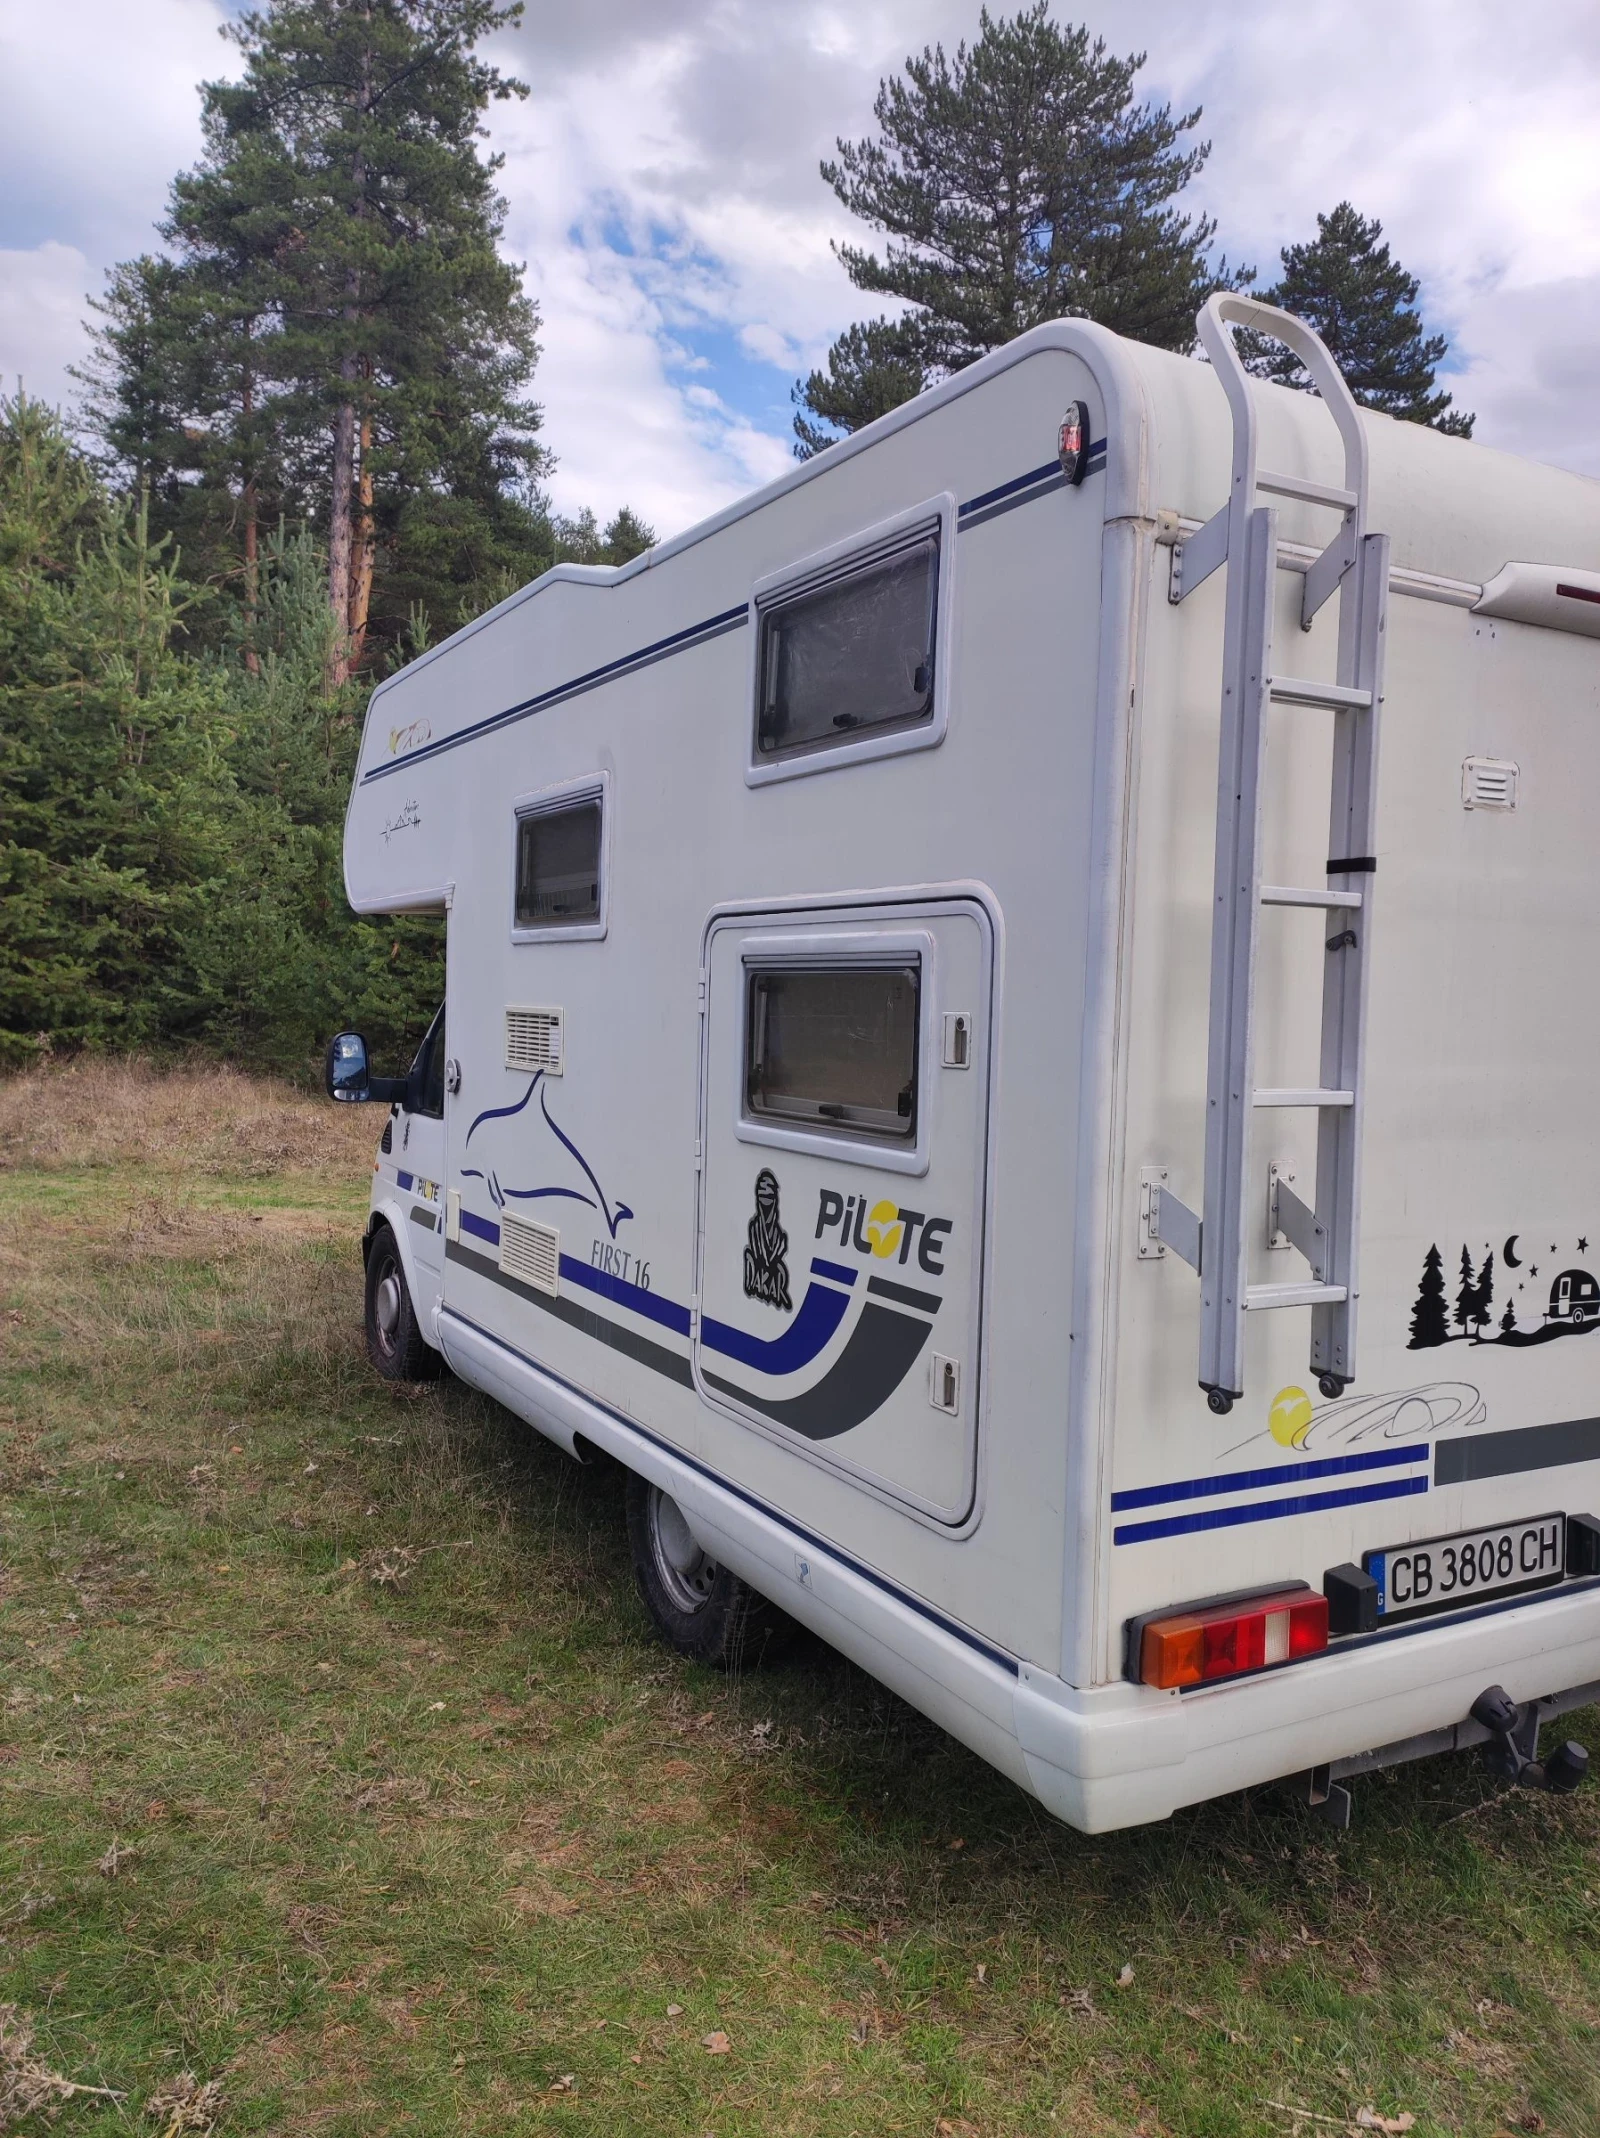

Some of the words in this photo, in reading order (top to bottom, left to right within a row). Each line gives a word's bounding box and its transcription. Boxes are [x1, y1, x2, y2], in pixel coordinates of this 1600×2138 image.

[591, 1239, 632, 1280] FIRST
[634, 1259, 651, 1291] 16
[745, 1252, 789, 1304] DAKAR
[1391, 1553, 1433, 1604] CB
[1440, 1535, 1514, 1592] 3808
[1520, 1523, 1558, 1573] CH
